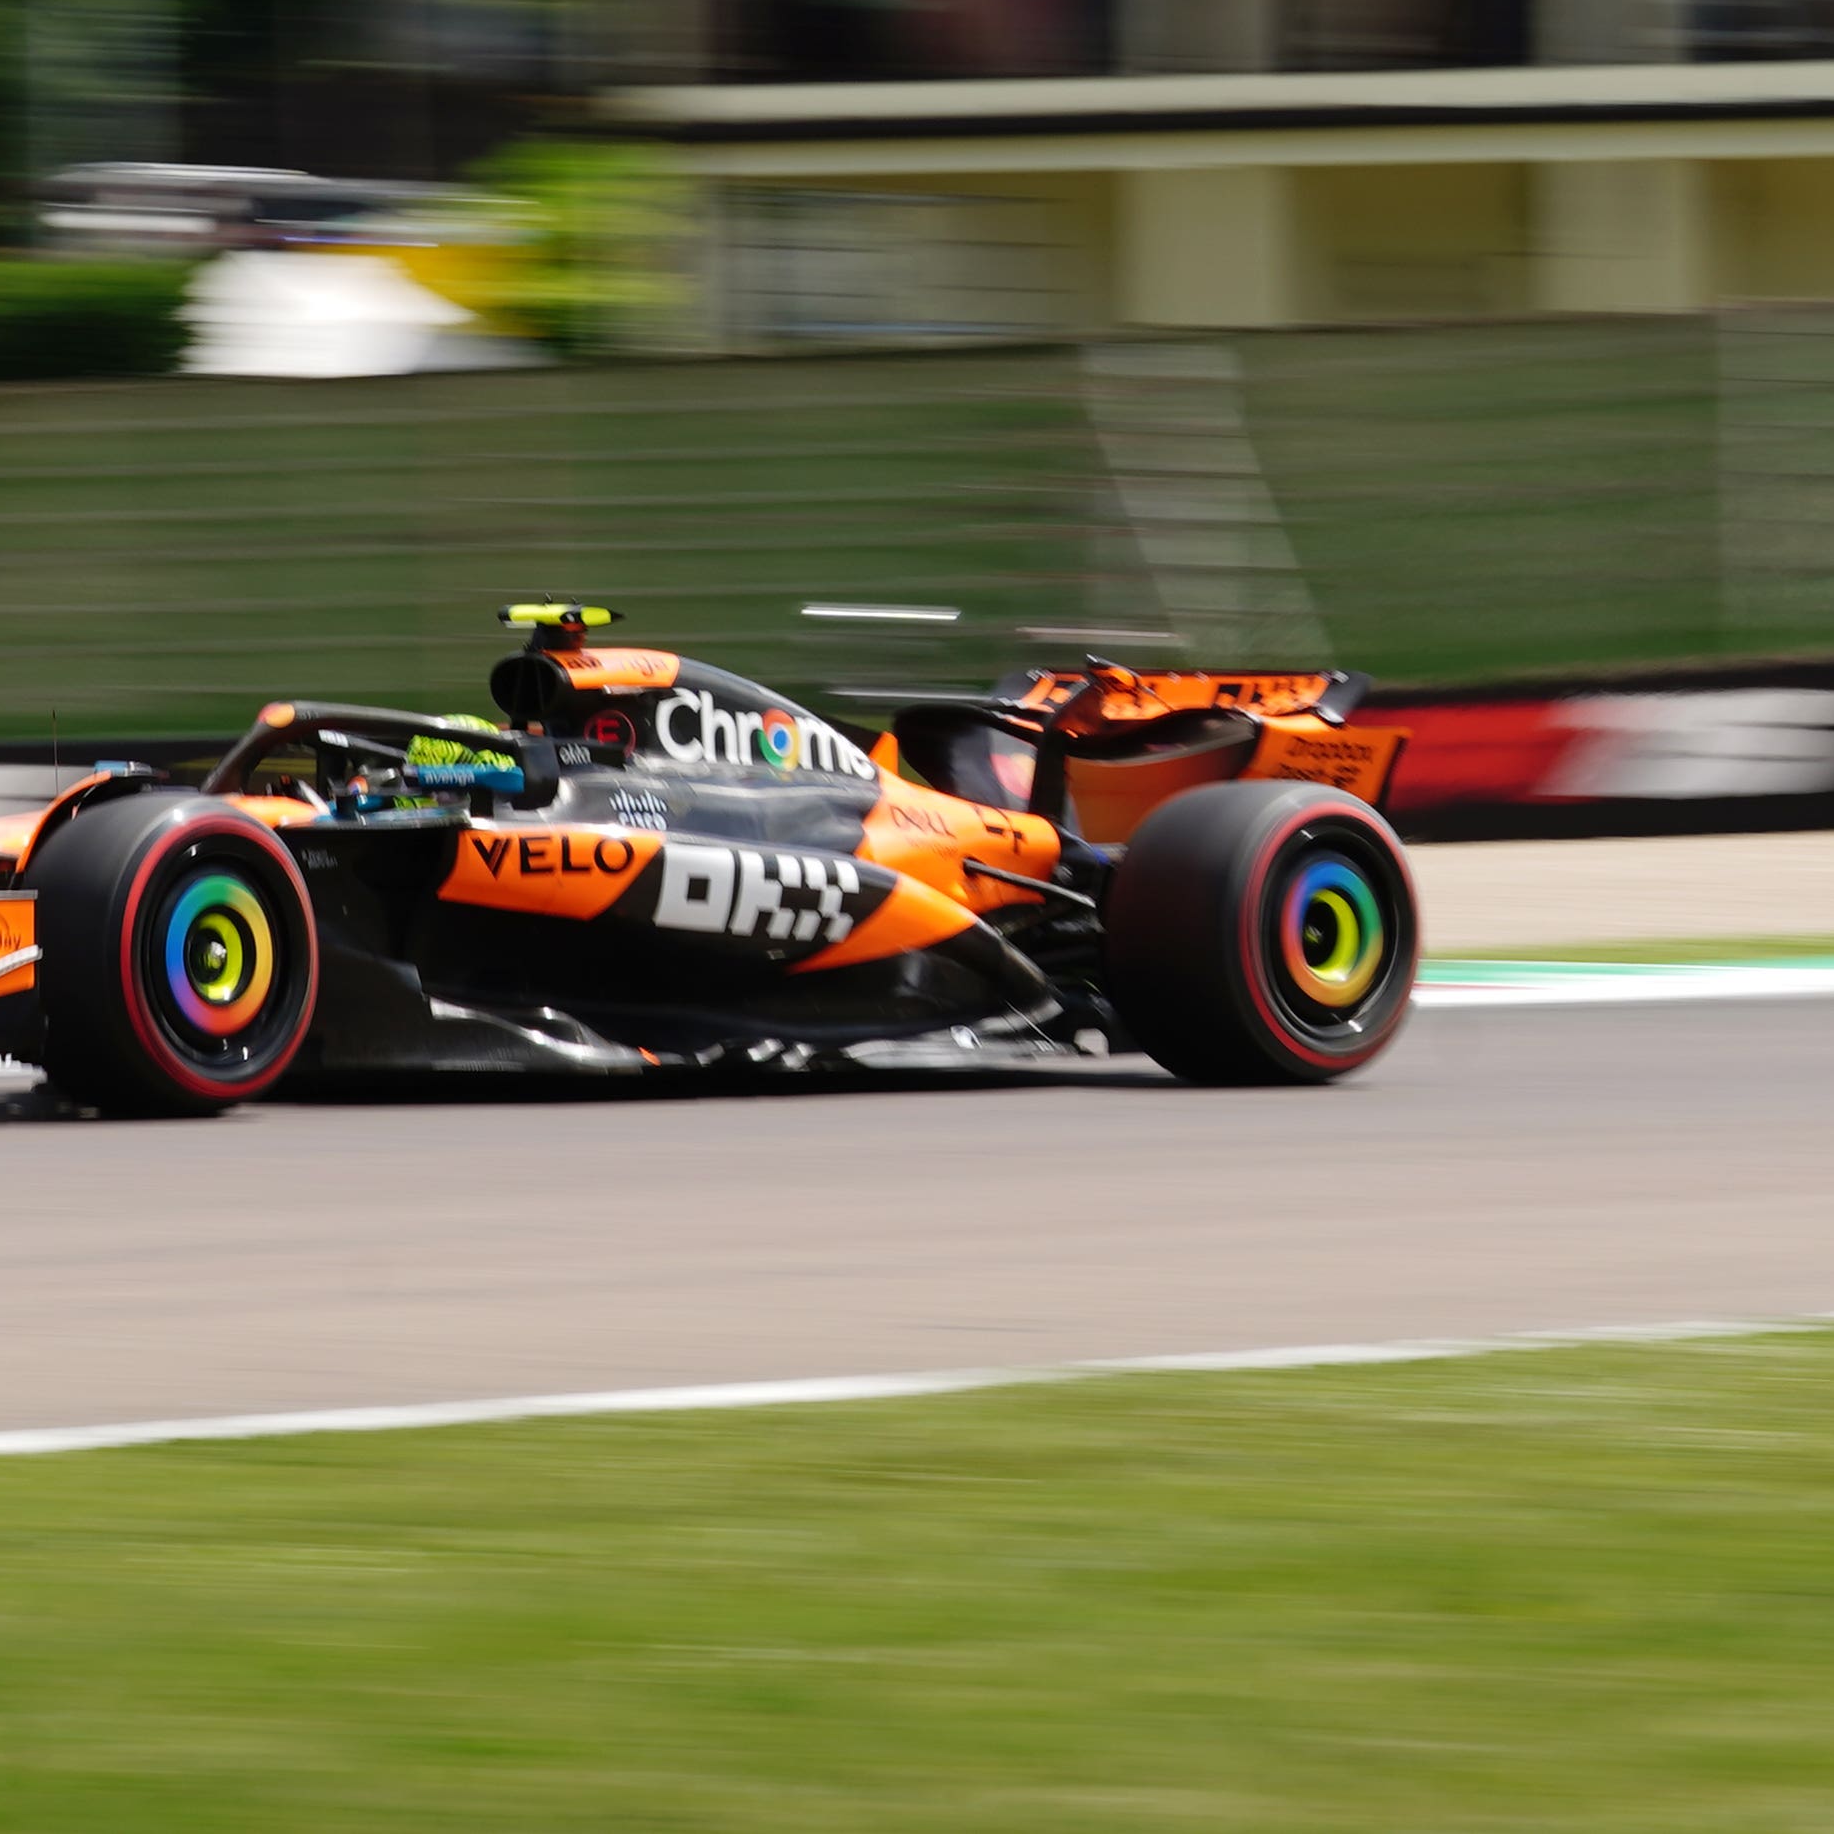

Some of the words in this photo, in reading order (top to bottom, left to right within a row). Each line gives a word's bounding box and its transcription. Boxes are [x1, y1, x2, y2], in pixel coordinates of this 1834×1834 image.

[655, 687, 876, 781] Chrome
[472, 835, 635, 880] VELO
[653, 844, 860, 943] OKX
